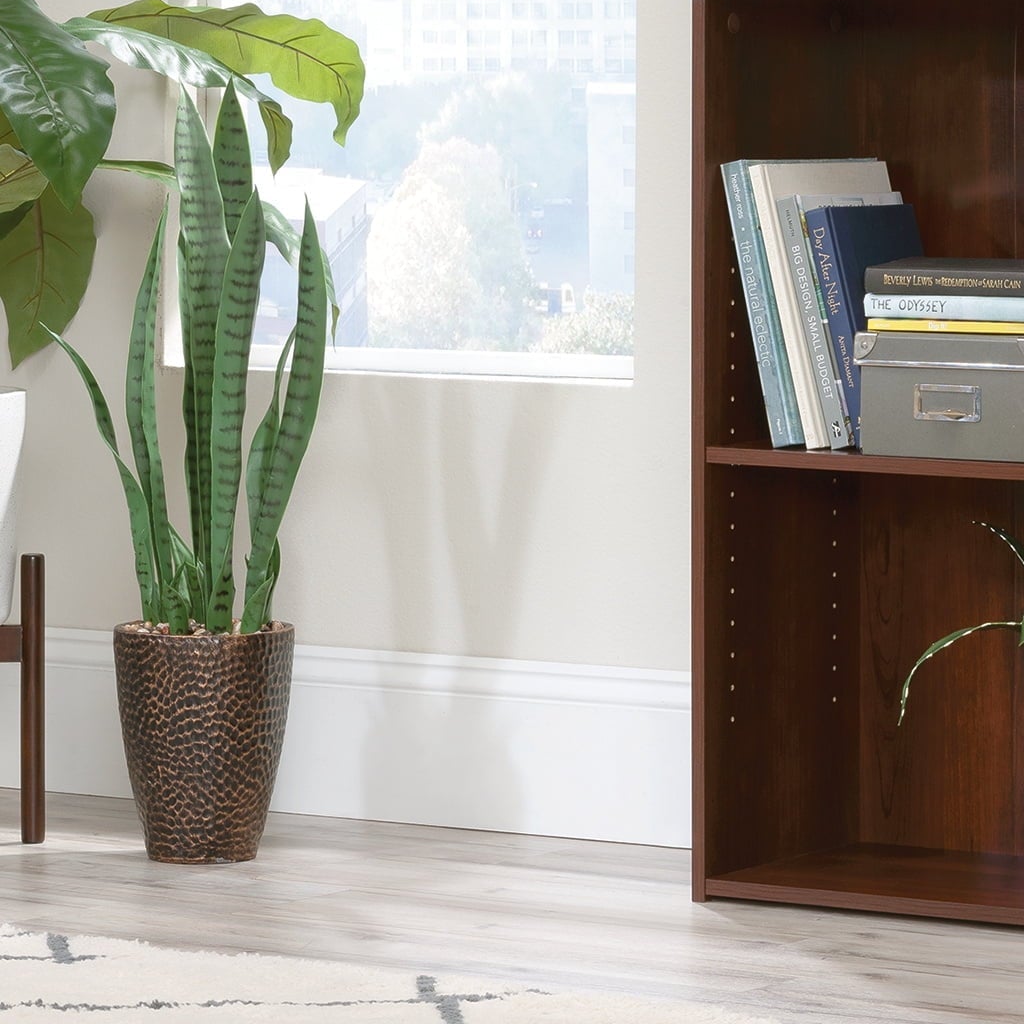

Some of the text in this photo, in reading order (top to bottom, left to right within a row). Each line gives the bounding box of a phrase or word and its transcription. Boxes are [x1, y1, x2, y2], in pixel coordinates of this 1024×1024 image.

[813, 227, 825, 250] Day
[730, 173, 771, 368] heather ross the natural eclectic
[791, 245, 803, 265] BIG
[818, 252, 832, 281] After
[796, 267, 813, 313] DESIGN,
[883, 274, 912, 287] BEVERLY
[912, 275, 934, 287] LEWIS
[941, 277, 978, 288] REDEMPTION
[982, 279, 1003, 289] SARAH
[1003, 279, 1021, 289] CAIN
[825, 282, 841, 316] Night
[870, 298, 947, 313] THE ODYSSEY
[807, 316, 822, 352] SMALL
[816, 354, 834, 399] BUDGET
